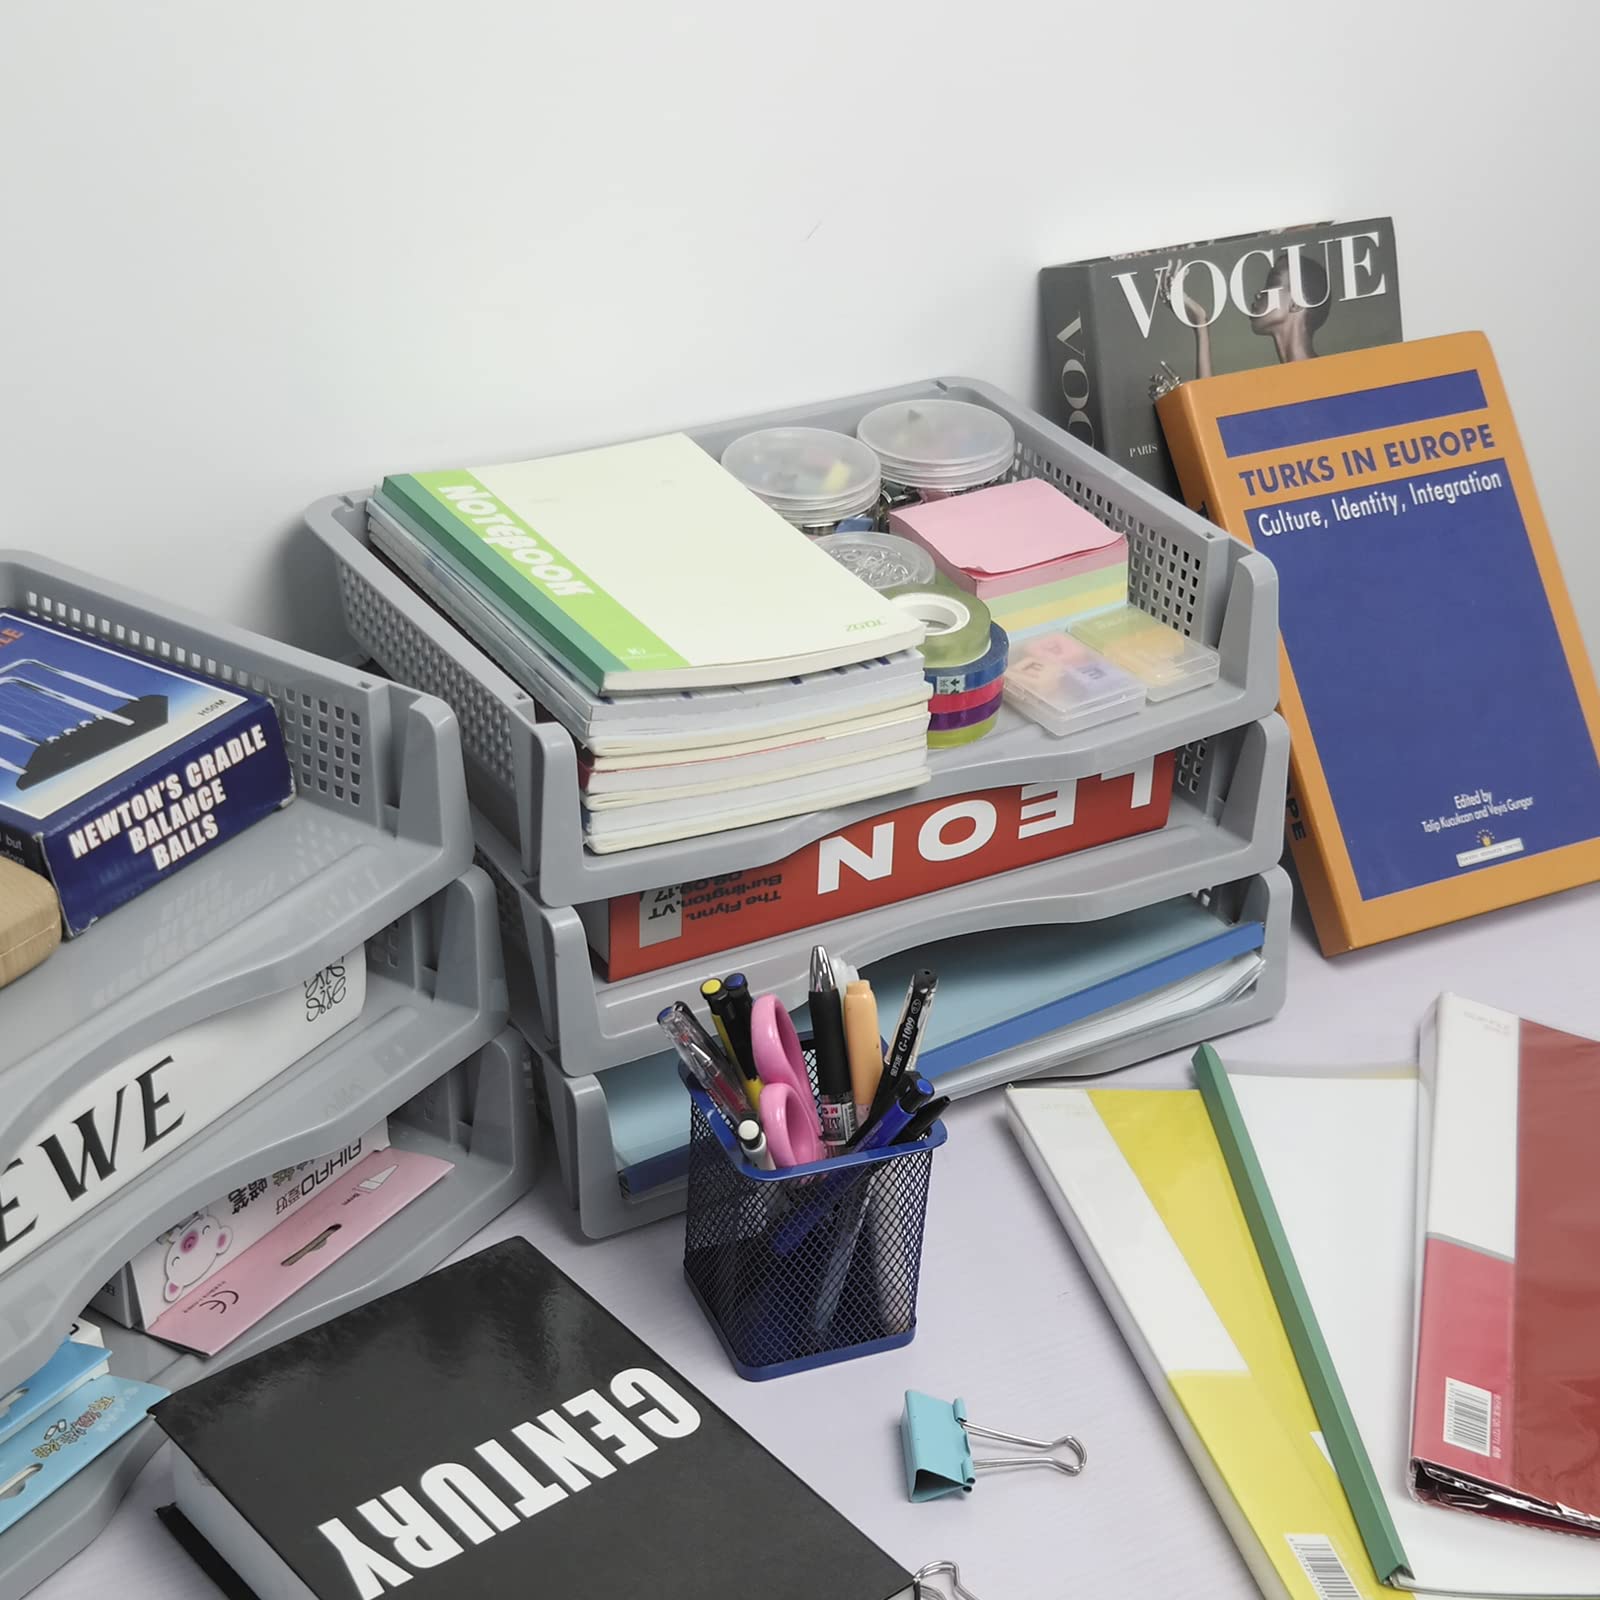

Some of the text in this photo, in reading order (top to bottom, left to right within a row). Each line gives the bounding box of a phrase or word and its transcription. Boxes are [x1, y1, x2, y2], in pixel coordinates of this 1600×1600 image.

[1111, 231, 1387, 339] VOGUE
[1129, 443, 1158, 457] PARIS
[1239, 424, 1496, 496] TURKS IN EUROPE
[1258, 470, 1502, 537] Culture, Identity, Integration
[437, 484, 597, 599] NOTEBOOK
[68, 724, 267, 860] NEWTON'S CRADLE
[128, 778, 227, 854] BALANCE
[1454, 789, 1493, 809] Edited by
[1473, 805, 1489, 820] and
[151, 813, 219, 872] BALLS
[817, 754, 1155, 896] LEON
[746, 890, 782, 906] The
[898, 1017, 915, 1052] G-1009
[301, 1137, 362, 1196] AIHAO
[276, 1184, 301, 1215] 爱好
[317, 1367, 702, 1600] CENTURY
